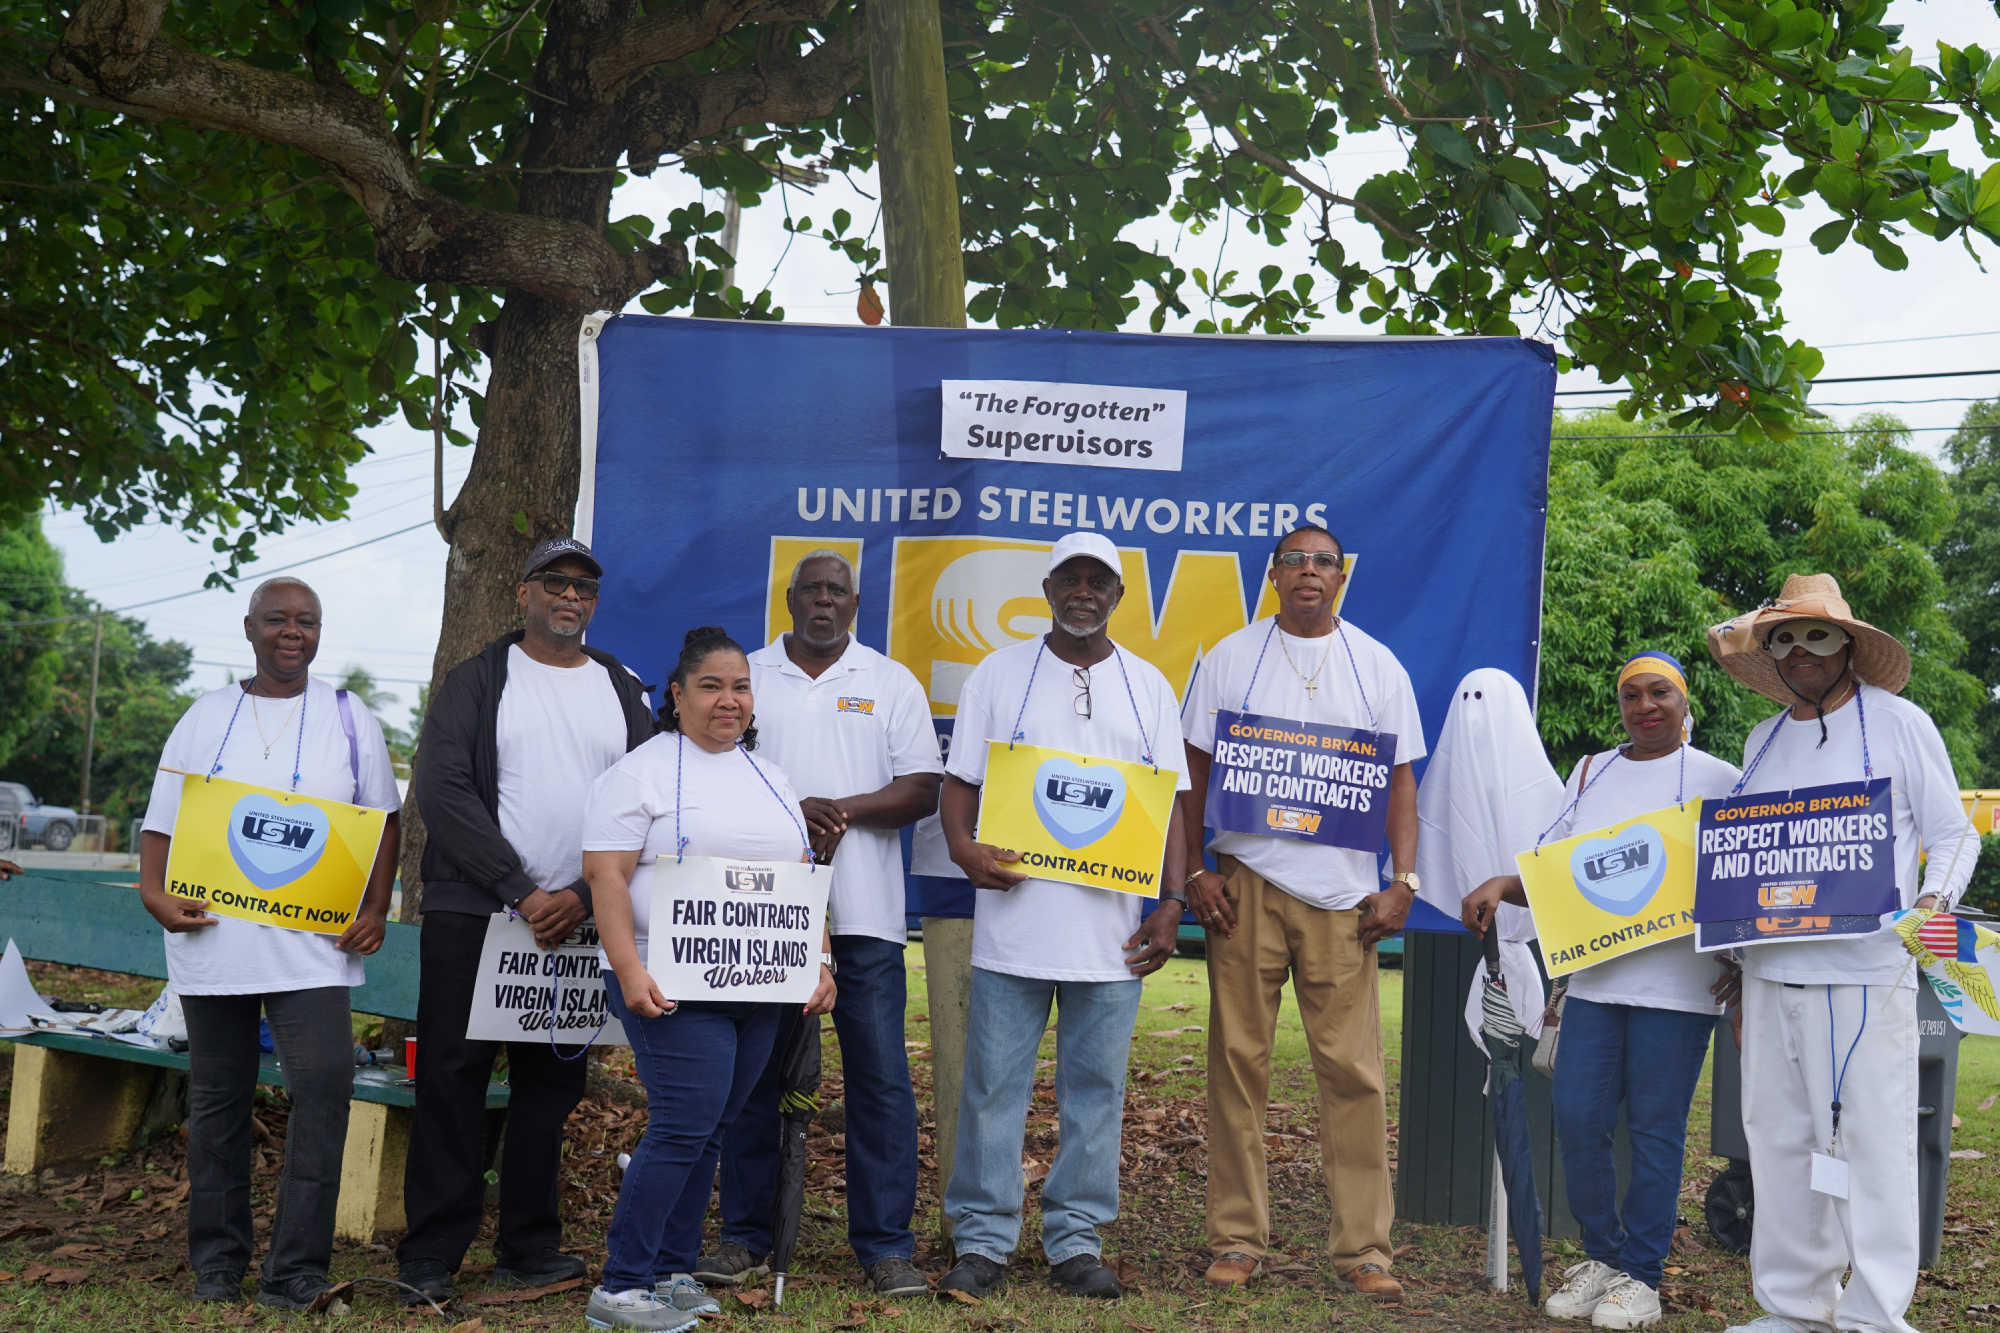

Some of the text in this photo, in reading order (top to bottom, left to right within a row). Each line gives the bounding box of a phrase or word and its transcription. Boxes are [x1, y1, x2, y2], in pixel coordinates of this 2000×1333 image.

[959, 390, 1166, 423] “The Forgotten”
[967, 424, 1153, 458] Supervisors
[797, 486, 1328, 537] UNITED STEELWORKERS
[1229, 724, 1377, 757] GOVERNOR BRYAN:
[1215, 740, 1388, 789] RESPECT WORKERS
[1046, 779, 1114, 809] USW
[1222, 768, 1372, 813] AND CONTRACTS
[1267, 808, 1323, 832] USW
[1715, 794, 1870, 821] GOVERNOR BRYAN:
[241, 816, 315, 849] USW
[1702, 813, 1887, 854] RESPECT WORKERS
[1021, 852, 1154, 885] CONTRACT NOW
[1584, 843, 1649, 880] USW
[1711, 844, 1873, 880] AND CONTRACTS
[725, 871, 776, 891] USW
[1757, 884, 1818, 906] USW
[170, 880, 351, 924] FAIR CONTRACT NOW
[672, 899, 810, 930] FAIR CONTRACTS
[672, 937, 808, 967] VIRGIN ISLANDS
[1550, 944, 1587, 965] FAIR
[1590, 914, 1676, 952] CONTRACT
[498, 951, 538, 976] FAIR
[703, 964, 788, 989] Workers
[495, 984, 555, 1010] VIRGIN
[518, 1010, 605, 1031] Workers
